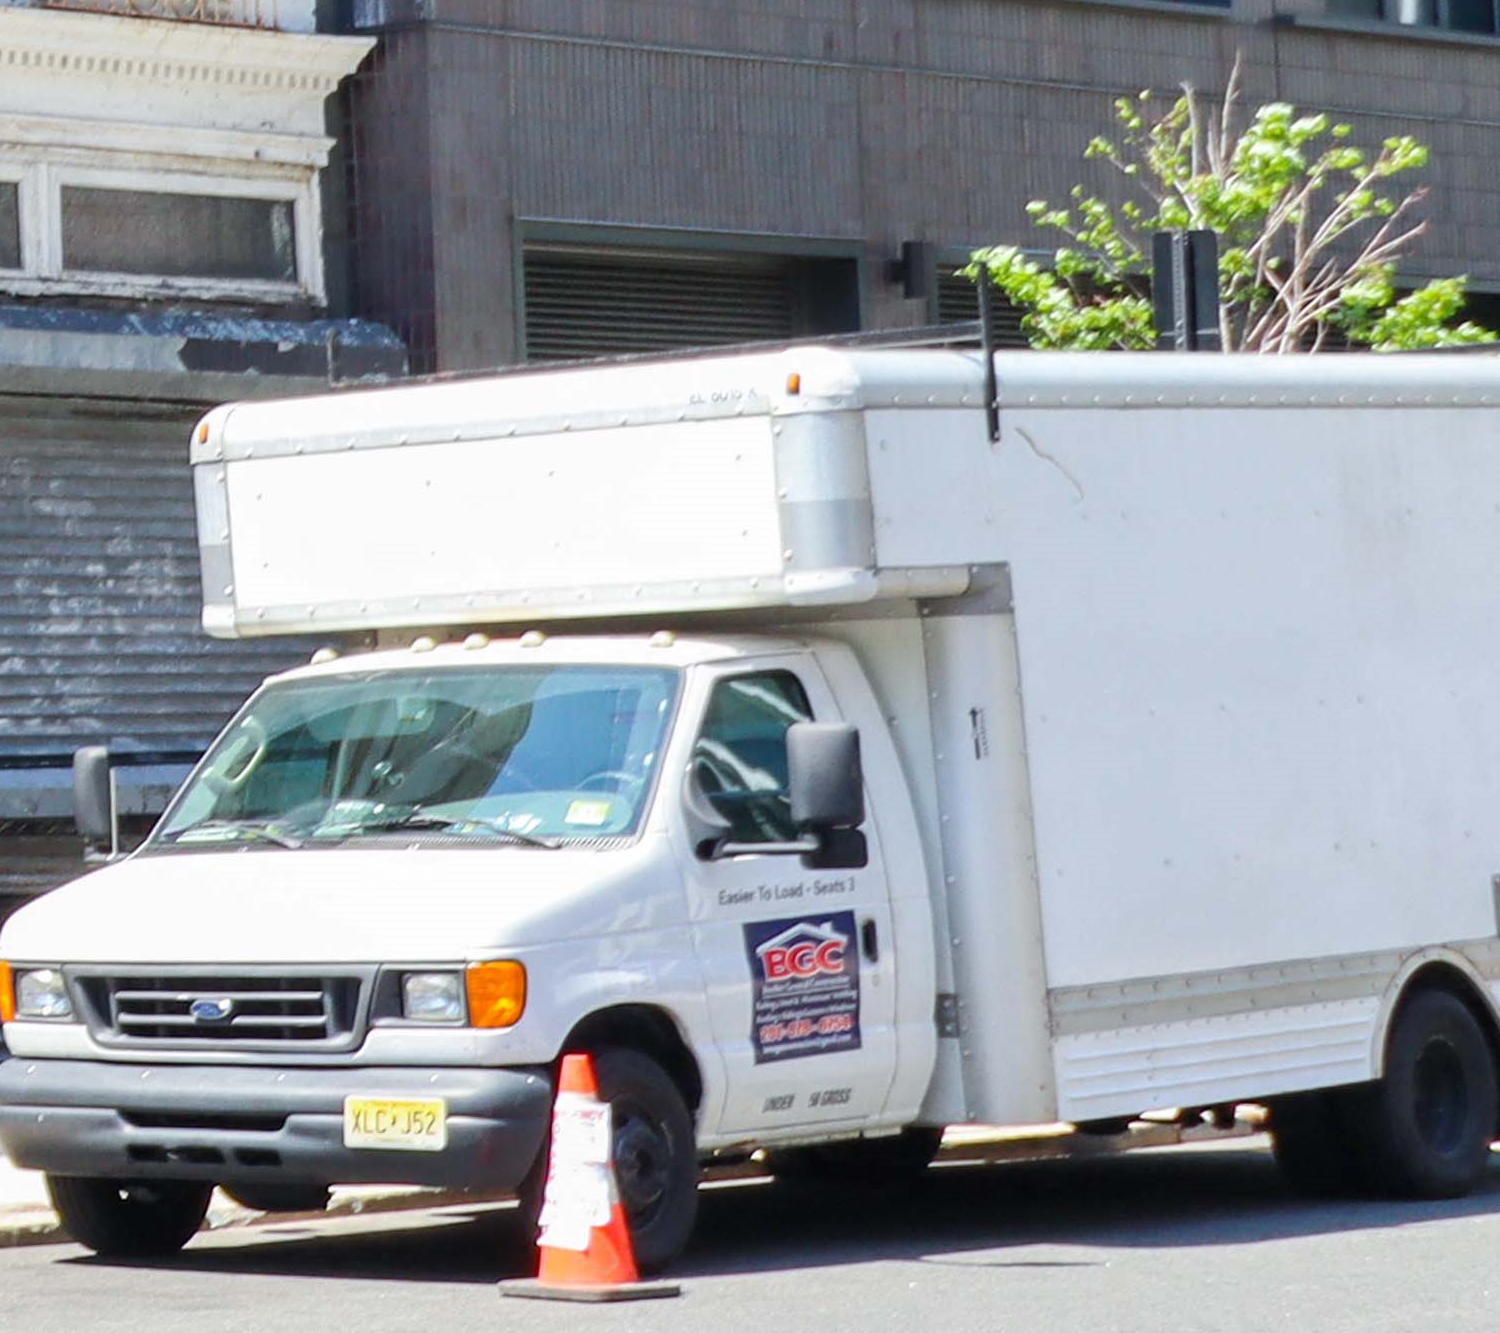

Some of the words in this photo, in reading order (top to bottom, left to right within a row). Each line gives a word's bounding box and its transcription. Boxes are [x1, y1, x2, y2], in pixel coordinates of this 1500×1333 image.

[718, 889, 754, 906] Easier
[758, 886, 772, 902] To
[775, 882, 804, 900] Load
[813, 880, 846, 896] Seats
[761, 939, 846, 982] BGC
